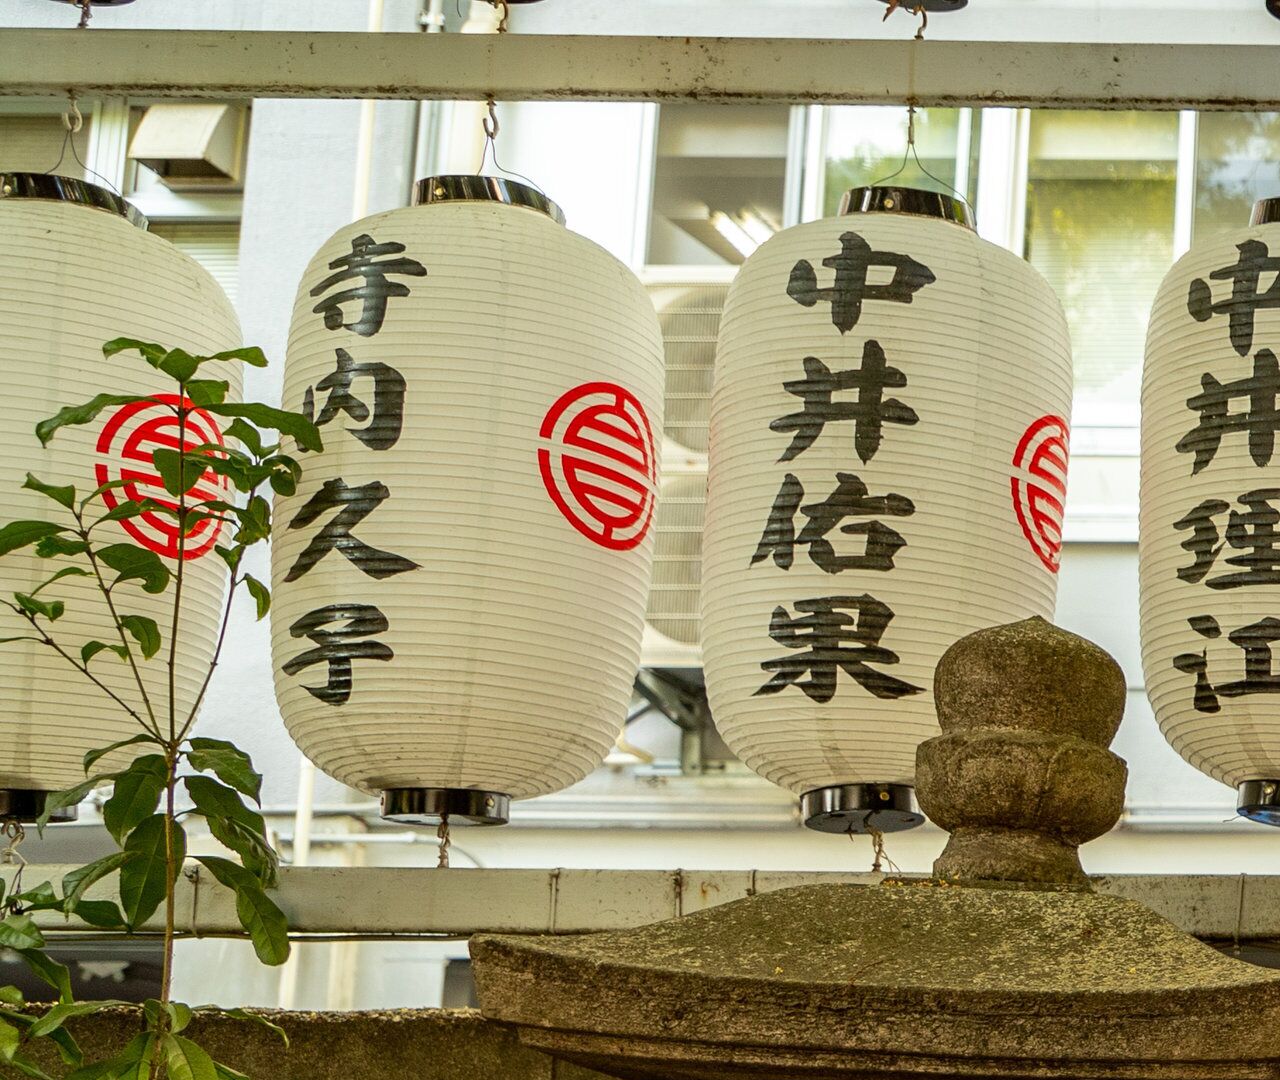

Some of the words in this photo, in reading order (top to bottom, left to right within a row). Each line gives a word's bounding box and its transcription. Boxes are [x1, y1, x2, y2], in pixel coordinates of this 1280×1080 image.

[282, 233, 427, 706] 寺内久子
[750, 231, 936, 701] 中井佑果
